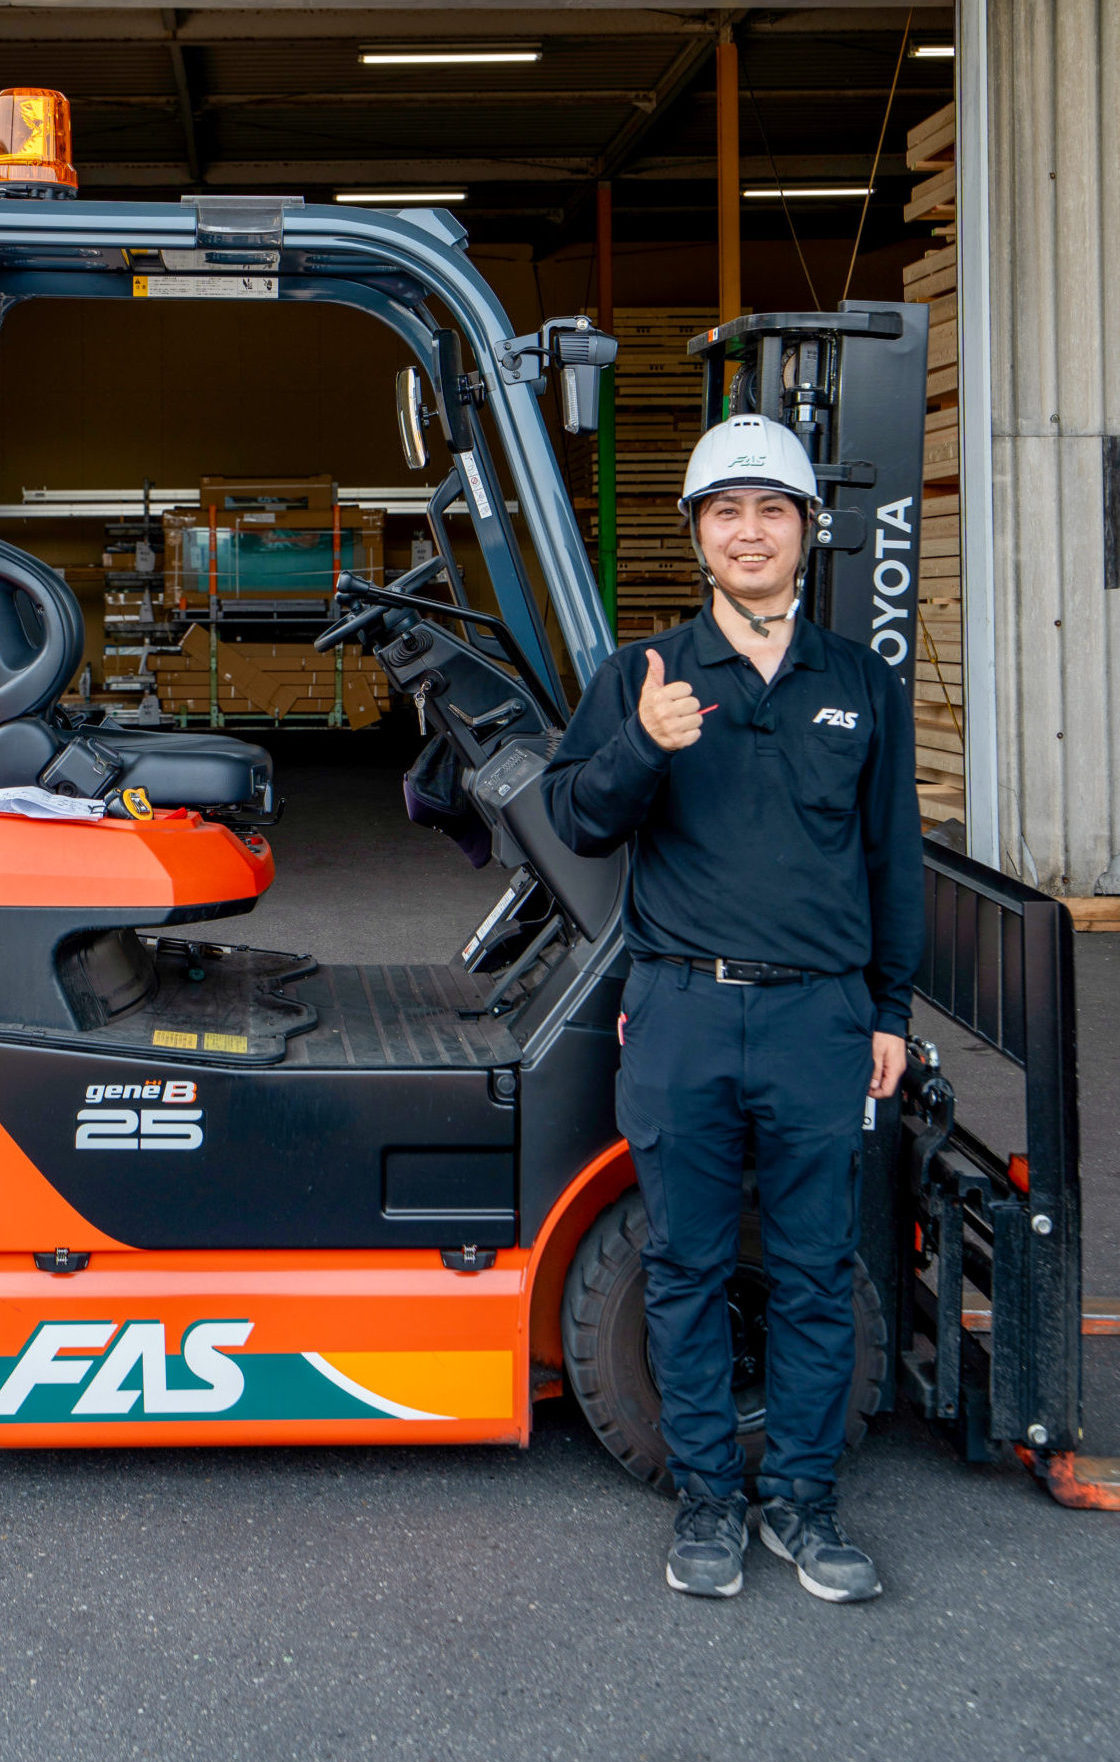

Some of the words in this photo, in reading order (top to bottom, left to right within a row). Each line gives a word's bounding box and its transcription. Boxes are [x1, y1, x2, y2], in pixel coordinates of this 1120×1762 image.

[728, 455, 767, 468] FAS
[870, 496, 913, 686] OYOTA
[812, 708, 860, 730] FAS
[75, 1109, 204, 1150] 25
[0, 1320, 256, 1416] FAS
